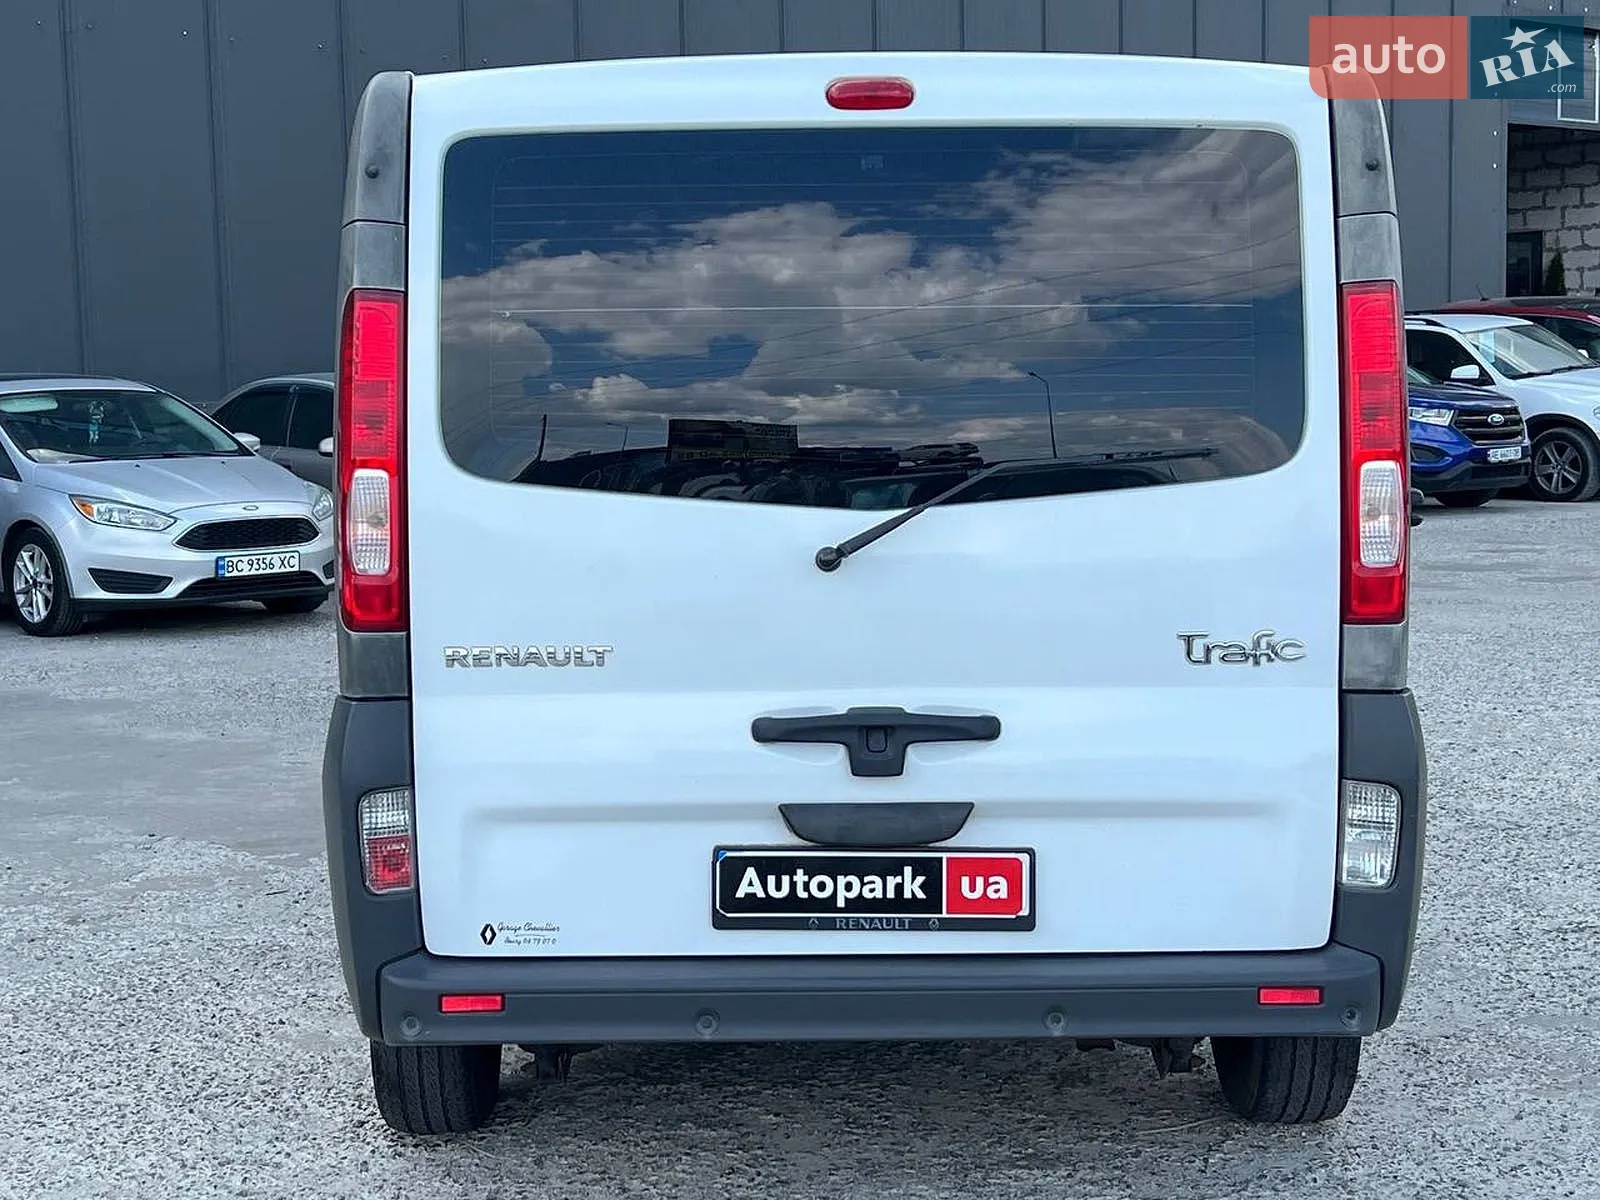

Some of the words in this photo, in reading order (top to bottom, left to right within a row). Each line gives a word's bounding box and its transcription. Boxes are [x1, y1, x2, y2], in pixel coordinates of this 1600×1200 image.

[226, 559, 244, 573] BC
[247, 557, 275, 572] 9356
[278, 555, 296, 569] XC
[443, 645, 614, 668] RENAULT
[1176, 629, 1307, 667] Trafic
[735, 866, 928, 908] Autopark
[960, 874, 1009, 899] ua
[835, 918, 912, 930] RENAULT
